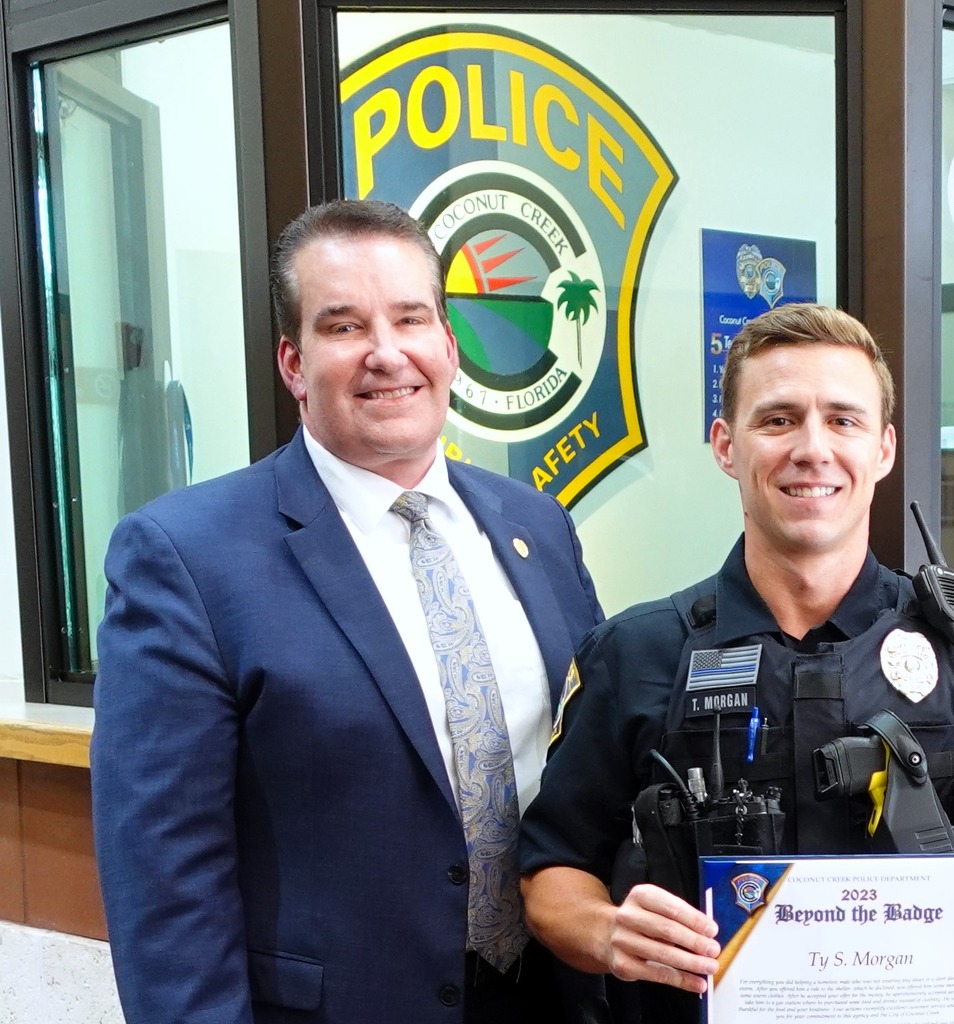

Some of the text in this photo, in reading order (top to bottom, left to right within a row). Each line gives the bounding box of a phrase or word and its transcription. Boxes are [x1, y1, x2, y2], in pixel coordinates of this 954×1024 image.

[353, 64, 626, 231] POLICE
[434, 193, 569, 257] COCONUT CREEK
[710, 331, 723, 356] 5
[506, 366, 568, 410] FLORIDA
[531, 411, 601, 492] AFETY
[692, 692, 748, 712] T. MORGAN
[787, 876, 826, 884] COCONUT
[841, 888, 878, 901] 2023
[774, 903, 944, 926] Beyond the Badge
[808, 950, 914, 972] Ty S. Morgan
